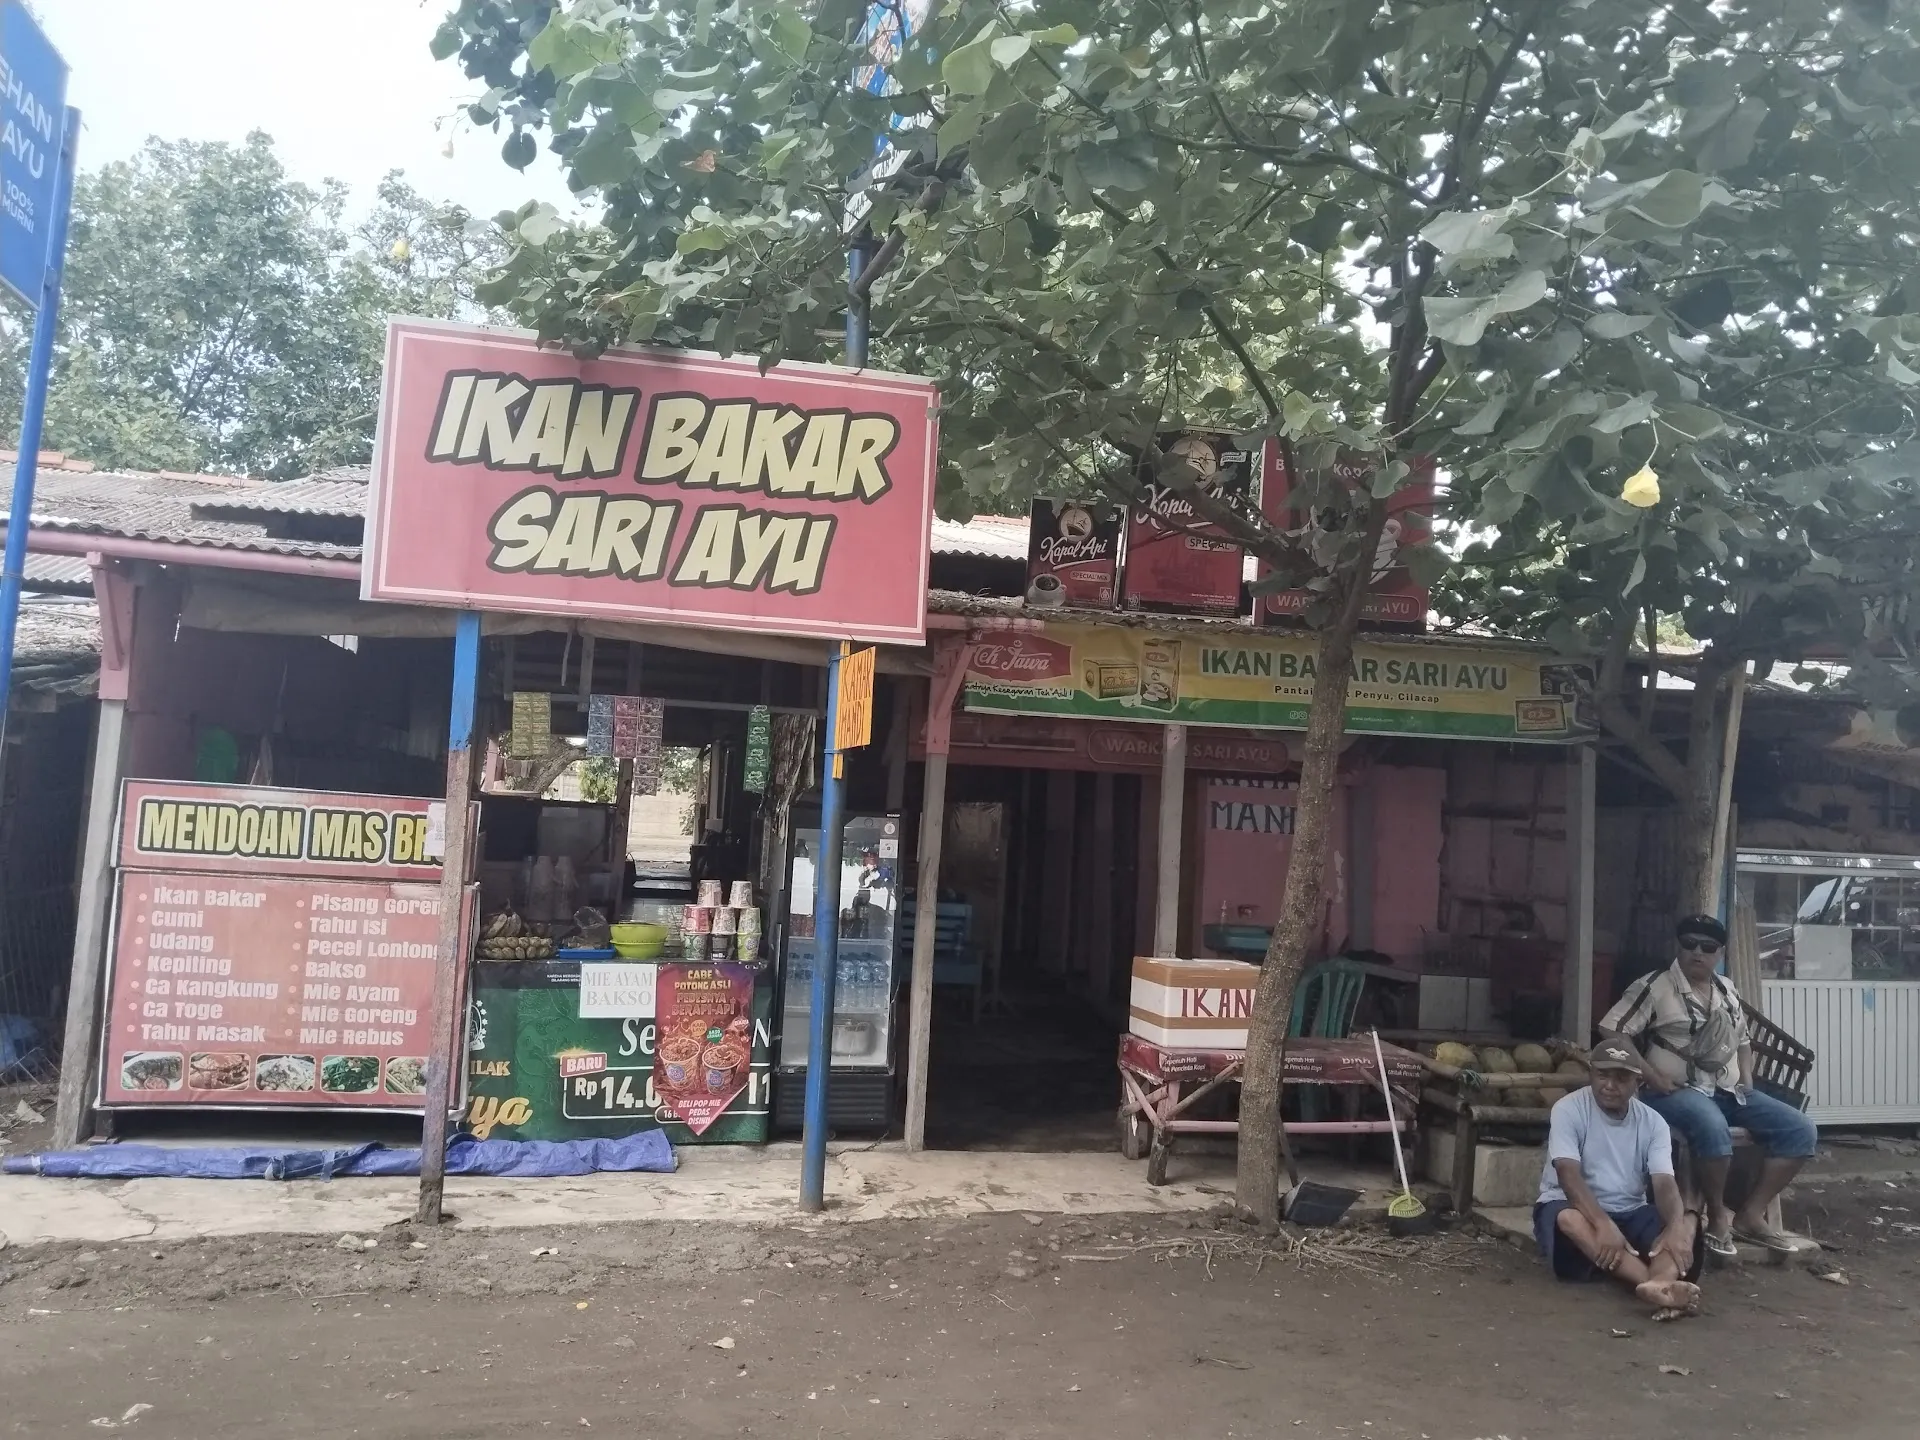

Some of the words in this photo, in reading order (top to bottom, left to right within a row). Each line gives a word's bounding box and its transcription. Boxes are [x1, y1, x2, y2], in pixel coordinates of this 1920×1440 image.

[2, 119, 45, 179] AYU
[6, 180, 34, 216] 100%
[2, 194, 35, 234] MURNI
[429, 371, 638, 478] IKAN
[640, 396, 896, 498] BAKAR
[491, 489, 677, 579] SARI
[673, 507, 833, 591] AYU
[1040, 536, 1082, 565] Kapal
[1080, 536, 1108, 559] Api
[1072, 572, 1096, 580] SPECIAL
[1381, 602, 1410, 614] AYU
[974, 644, 1003, 669] Teh
[1002, 645, 1053, 671] Jawa
[1202, 649, 1272, 677] IKAN
[1279, 653, 1379, 683] BAAR
[1386, 659, 1448, 687] SARI
[1455, 664, 1508, 690] AYU
[1275, 685, 1314, 696] Pantai
[1355, 690, 1394, 702] Penyu,
[1398, 692, 1440, 704] Cilacap
[1193, 743, 1231, 759] SARI
[1235, 748, 1271, 762] AYU
[141, 801, 303, 857] MENDOAN
[310, 812, 384, 860] MAS
[392, 816, 443, 863] BR
[153, 887, 197, 905] Ikan
[204, 889, 267, 908] Bakar
[311, 895, 378, 914] Pisang
[384, 898, 440, 916] Goren
[151, 910, 203, 928] Cumi
[309, 917, 357, 935] Tahu
[363, 918, 387, 936] Isi
[149, 932, 214, 952] Udang
[307, 939, 362, 956] Pecel
[147, 955, 232, 976] Kepiting
[305, 961, 366, 979] Bakso
[687, 969, 713, 980] CABE
[145, 977, 172, 995] Ca
[176, 979, 279, 999] Kangkung
[584, 971, 611, 986] MIE
[614, 971, 653, 986] AYAM
[675, 981, 708, 990] POTONG
[710, 980, 731, 989] ASLI
[303, 983, 342, 1000] Mie
[346, 985, 400, 1003] Ayam
[586, 990, 652, 1006] BAKSO
[1181, 988, 1252, 1018] IKAN
[143, 1000, 171, 1018] Ca
[175, 1001, 223, 1020] Toge
[301, 1006, 340, 1023] Mie
[345, 1008, 417, 1026] Goreng
[141, 1023, 192, 1040] Tahu
[196, 1025, 265, 1042] Masak
[300, 1028, 337, 1045] Mie
[342, 1030, 403, 1046] Rebus
[566, 1056, 603, 1073] BARU
